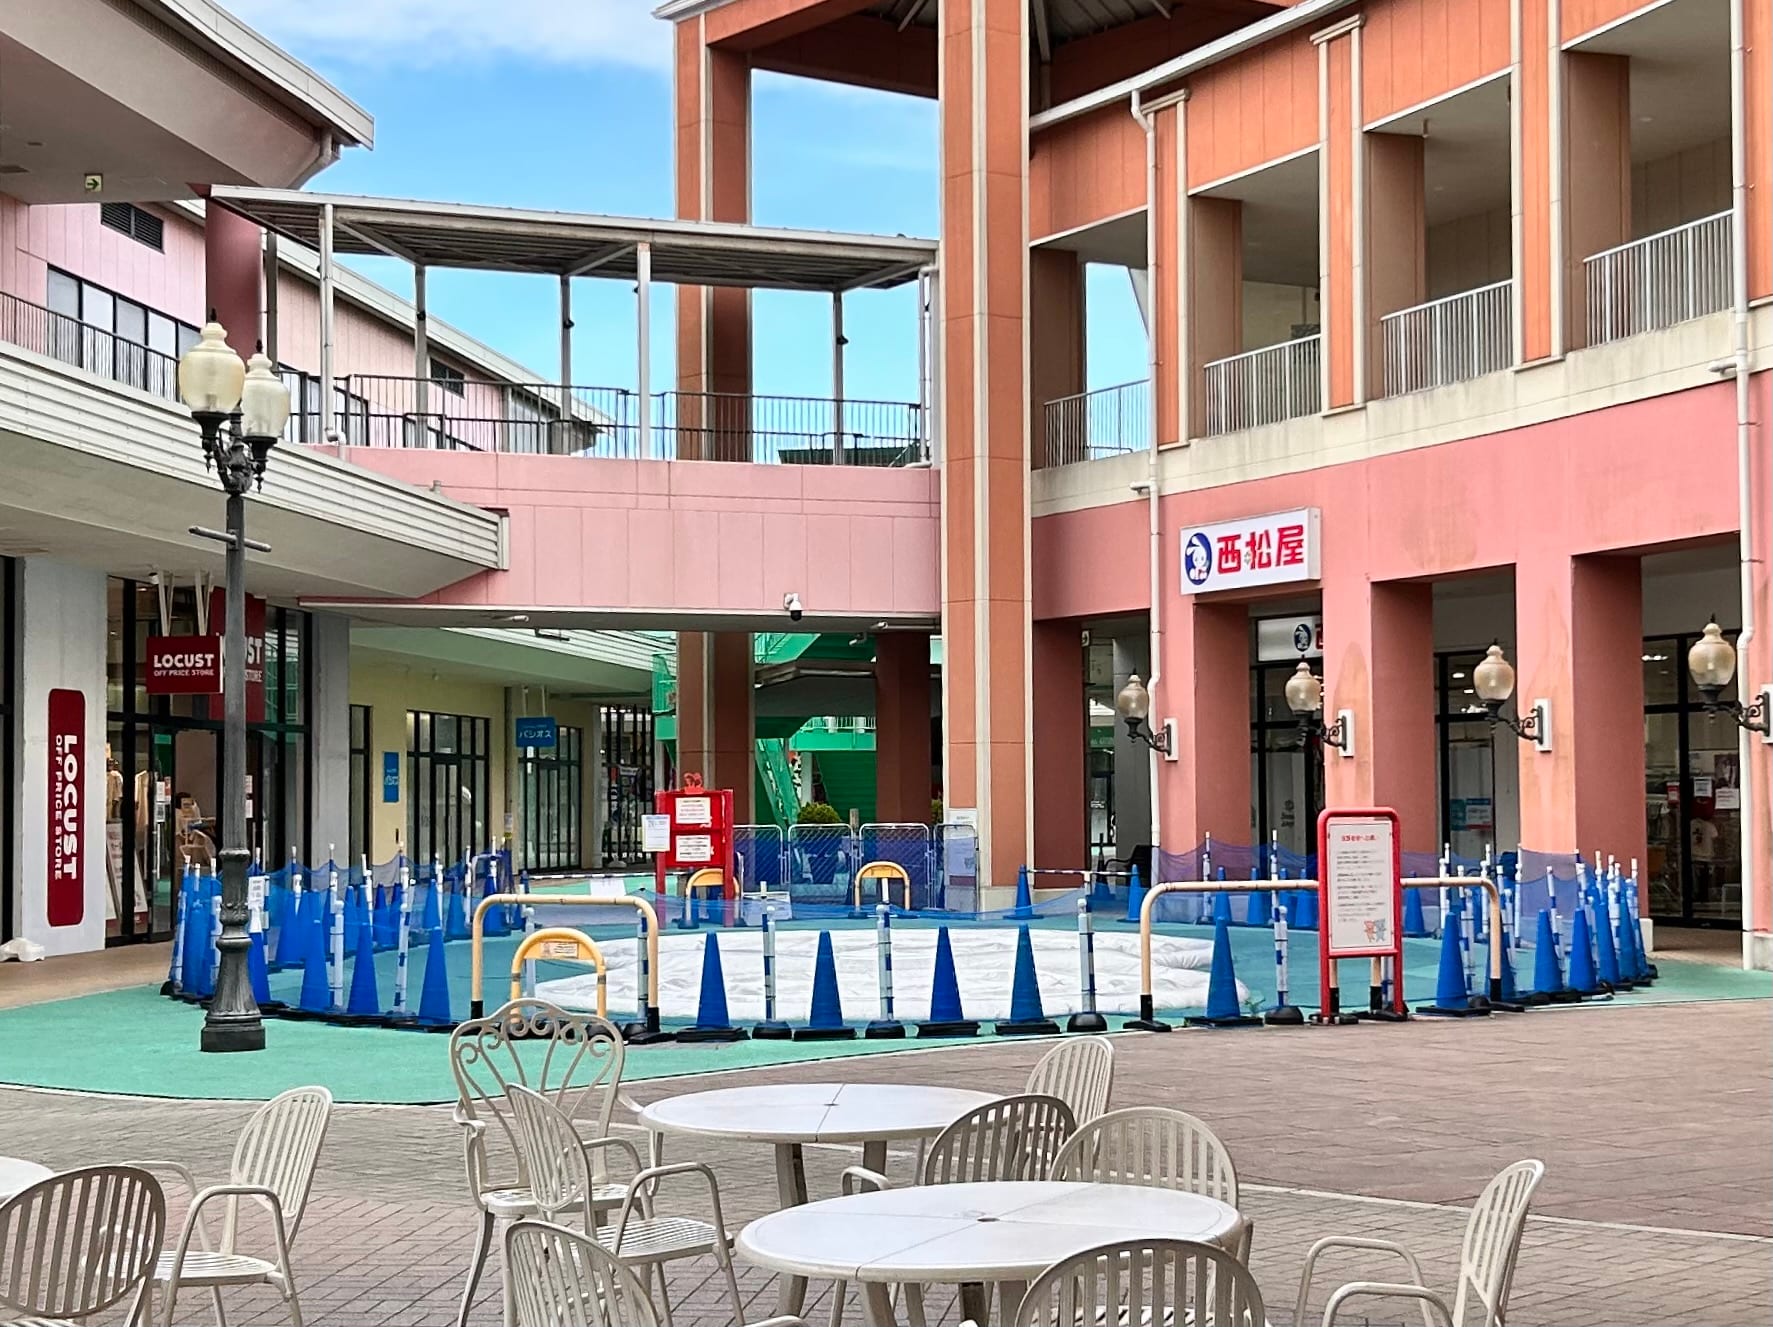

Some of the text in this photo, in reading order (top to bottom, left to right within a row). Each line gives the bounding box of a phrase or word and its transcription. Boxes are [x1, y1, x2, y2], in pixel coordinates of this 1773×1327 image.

[1216, 524, 1304, 575] 西松屋
[153, 653, 215, 668] LOCUST
[153, 668, 215, 677] OFF PRICE STORE
[63, 734, 78, 880] LOCUST
[54, 823, 62, 880] STORE
